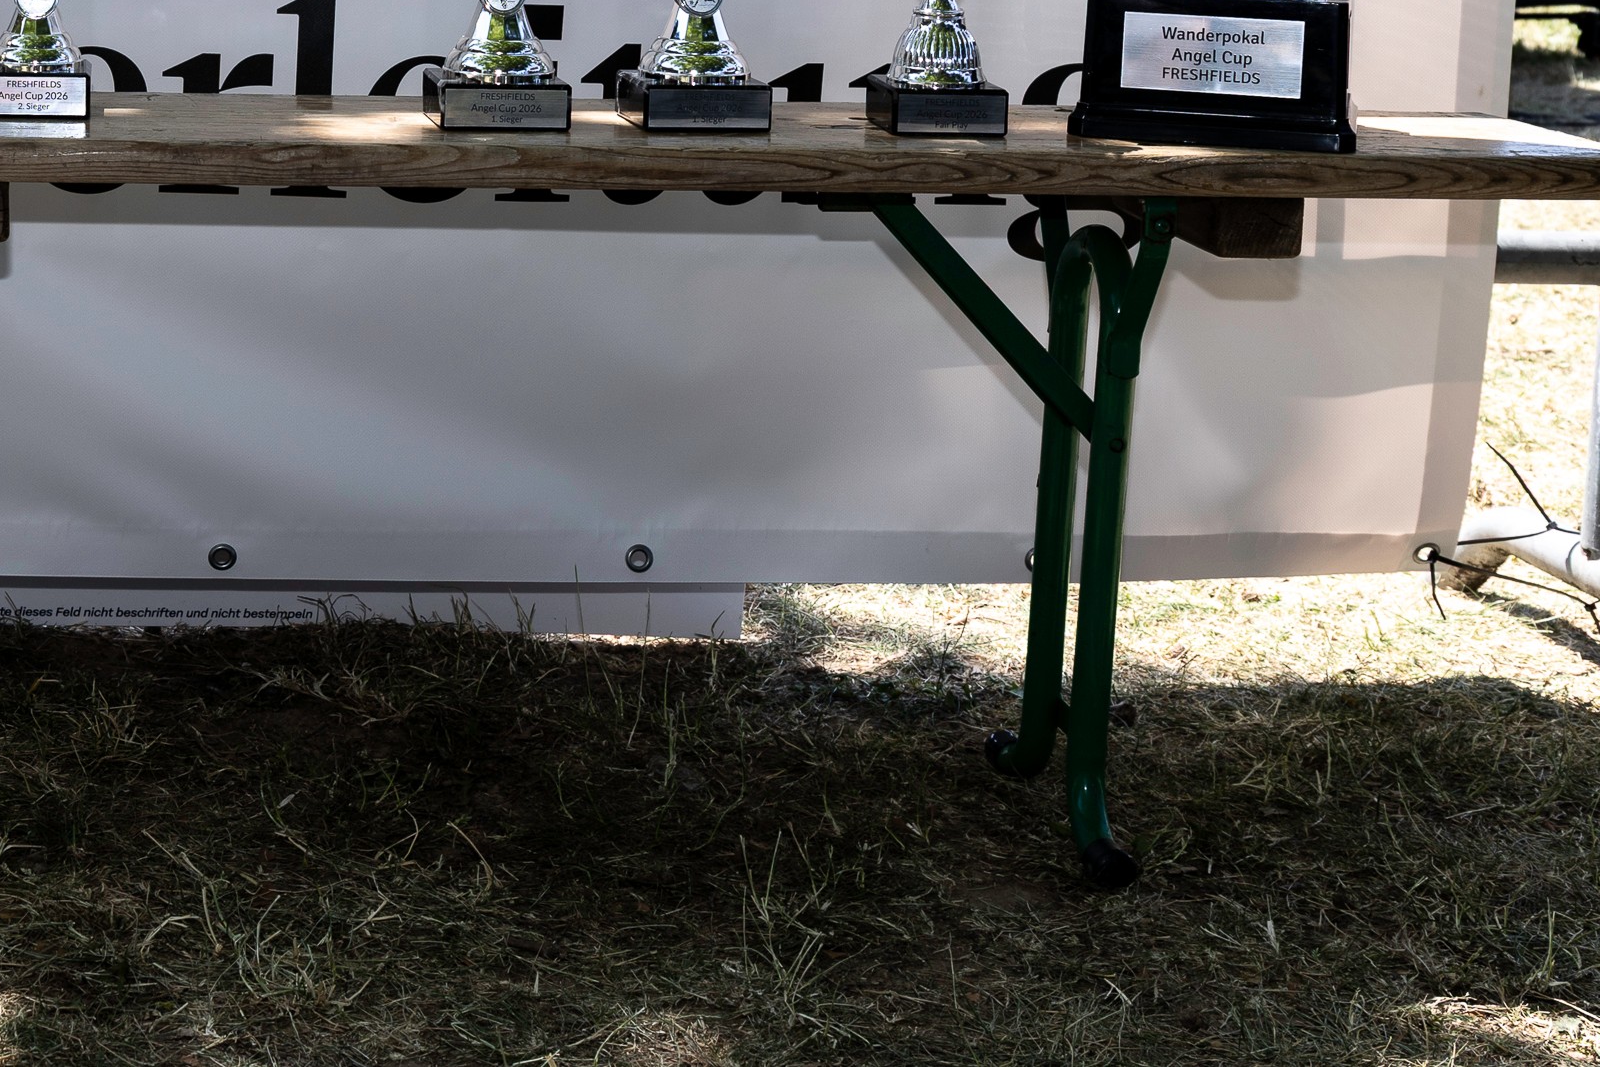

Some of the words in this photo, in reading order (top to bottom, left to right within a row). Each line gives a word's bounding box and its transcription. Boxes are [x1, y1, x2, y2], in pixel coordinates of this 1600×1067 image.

[1162, 26, 1265, 46] Wanderpokal
[1172, 48, 1217, 64] Angel
[1222, 51, 1252, 68] Cup
[1162, 67, 1261, 84] FRESHFIELDS
[7, 80, 61, 88] FRESHFIELDS
[25, 92, 43, 101] Cup
[46, 92, 68, 100] 2026
[26, 103, 50, 111] Sieger
[471, 104, 496, 113] Angel
[499, 104, 516, 114] Cup
[519, 104, 542, 113] 2026
[499, 116, 523, 124] Sieger
[701, 116, 726, 124] Sieger
[952, 121, 968, 130] Play
[15, 607, 52, 617] dieses
[56, 607, 80, 617] Feld
[83, 607, 114, 618] nicht
[116, 607, 183, 618] beschriften
[186, 608, 209, 618] und
[211, 608, 241, 618] nicht
[243, 608, 312, 620] bestempeln
